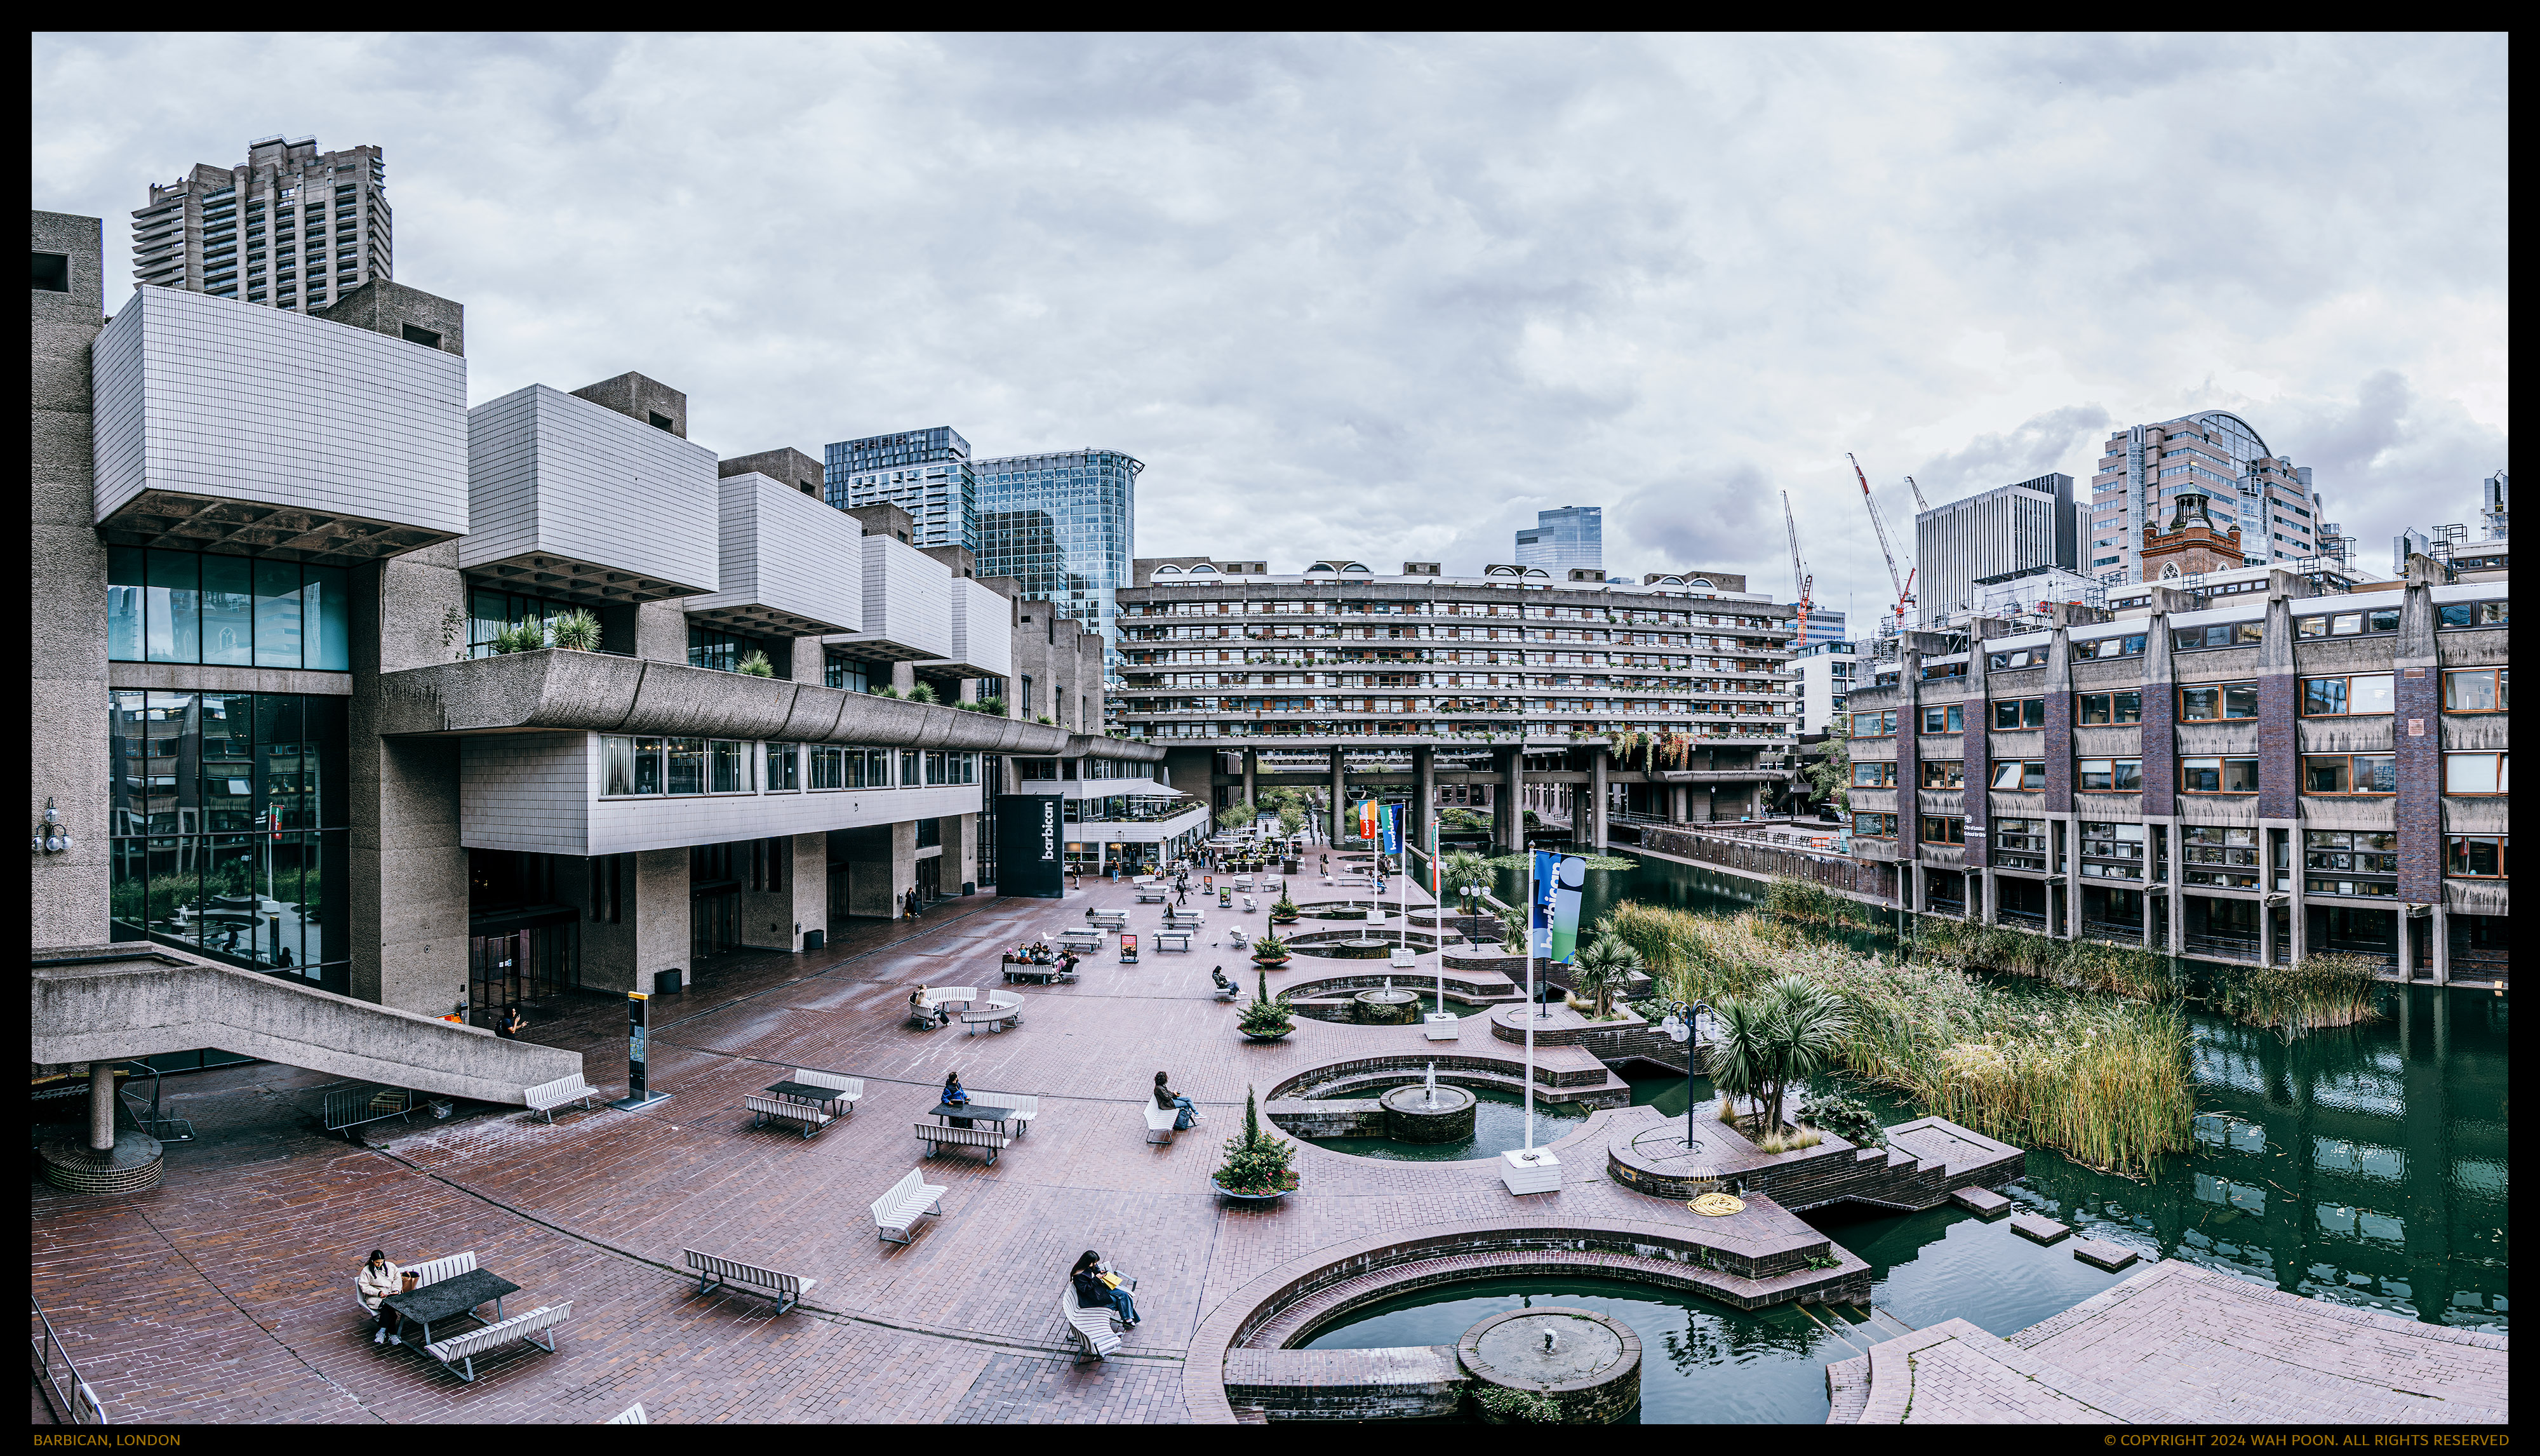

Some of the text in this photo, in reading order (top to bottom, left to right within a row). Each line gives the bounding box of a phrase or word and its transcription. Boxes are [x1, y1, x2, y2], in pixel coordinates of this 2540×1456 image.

[1041, 801, 1053, 860] barbican
[1387, 808, 1397, 850] barbican
[1541, 862, 1561, 949] barbican
